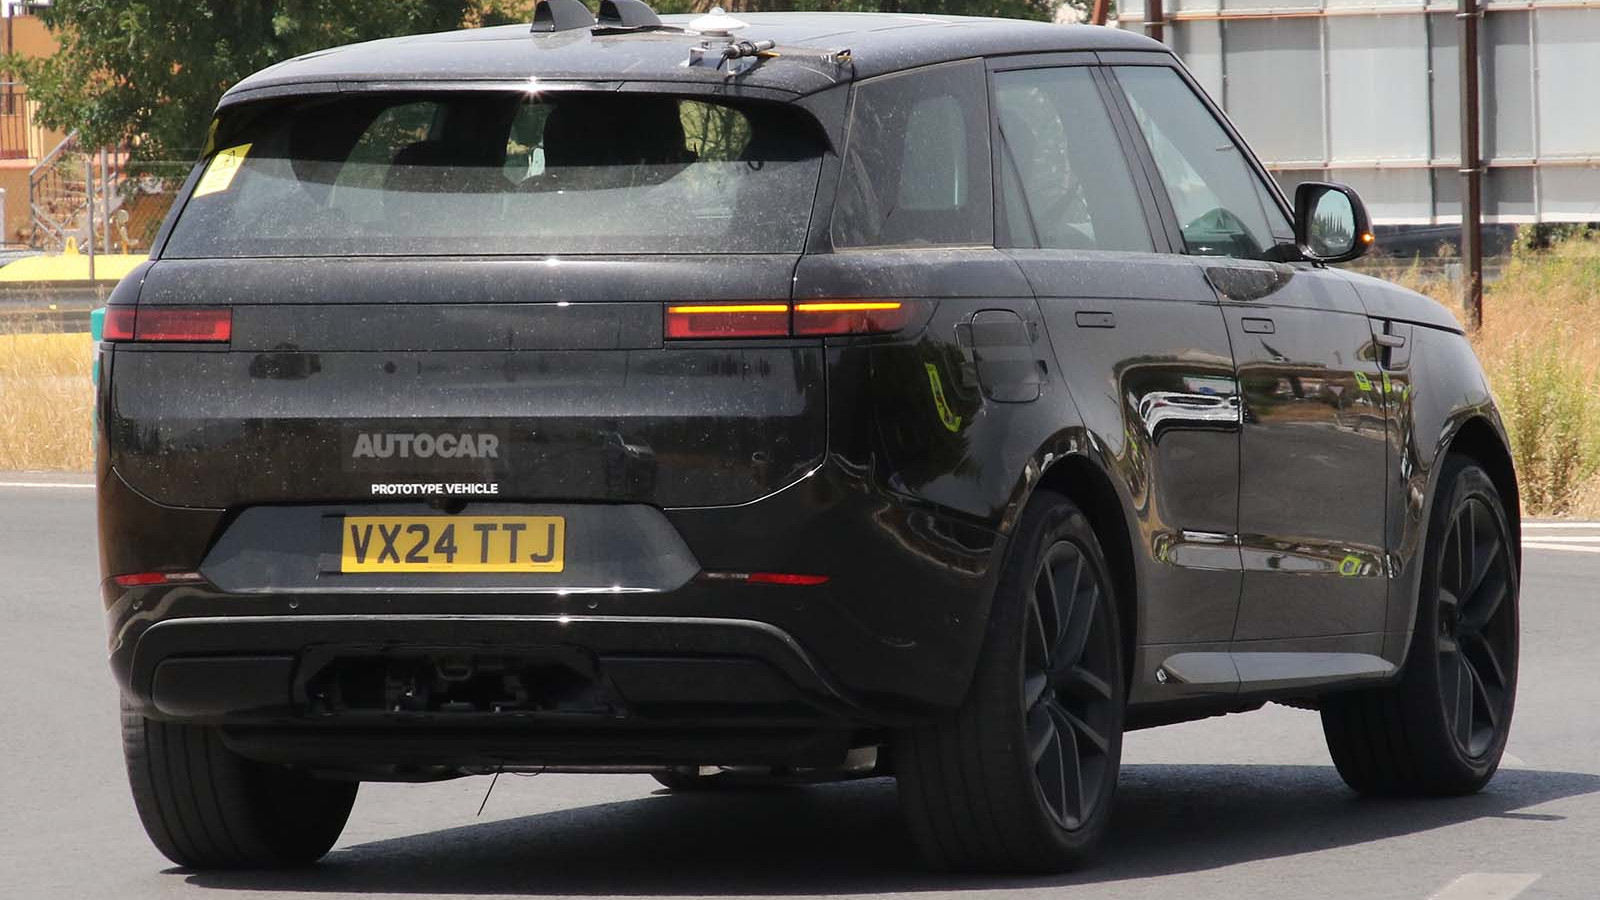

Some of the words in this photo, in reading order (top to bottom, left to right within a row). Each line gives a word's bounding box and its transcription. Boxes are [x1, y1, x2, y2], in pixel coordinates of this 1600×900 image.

[371, 483, 443, 495] PROTOTYPE
[445, 483, 499, 494] VEHICLE
[351, 523, 458, 564] VX24
[473, 523, 556, 564] TTJ
